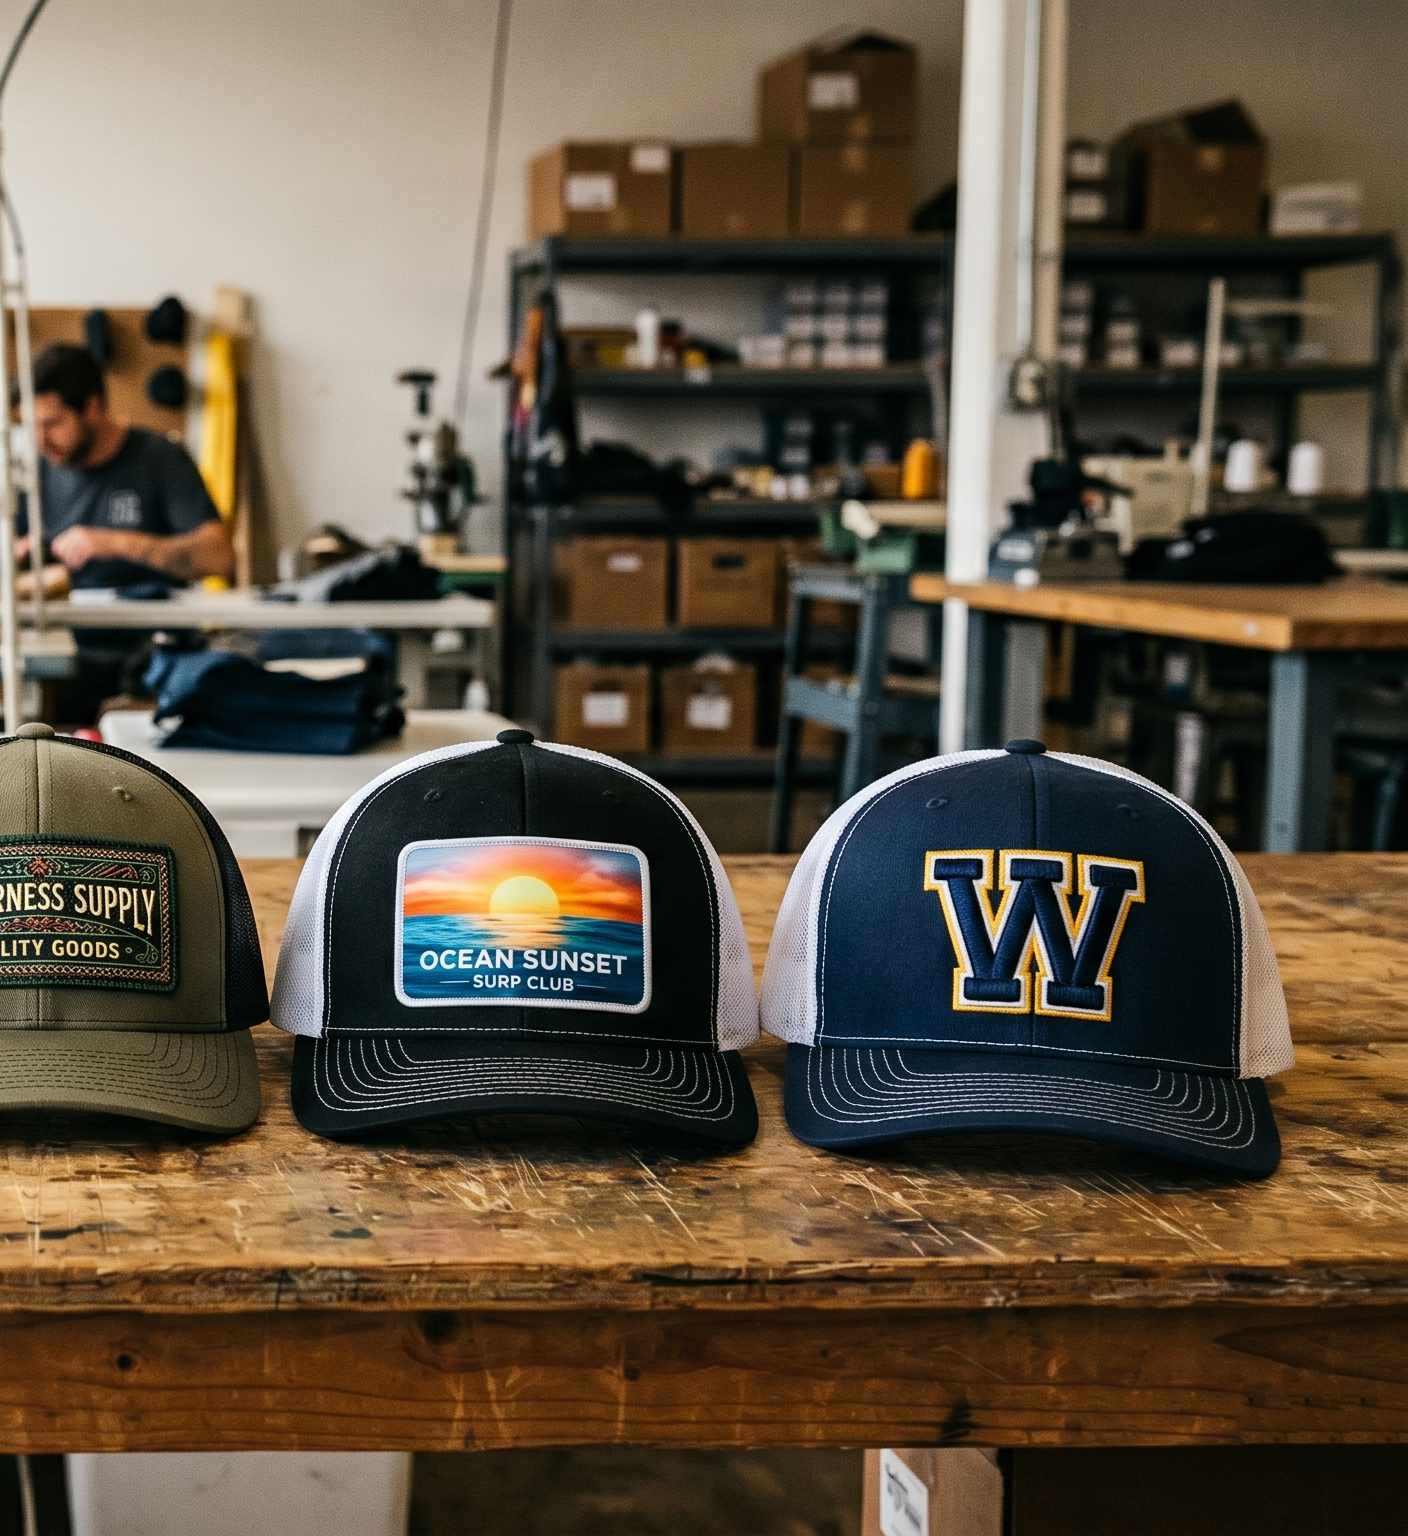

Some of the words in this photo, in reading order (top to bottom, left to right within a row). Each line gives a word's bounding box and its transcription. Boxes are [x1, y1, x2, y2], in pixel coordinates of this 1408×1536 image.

[74, 884, 155, 936] SUPPLY
[924, 849, 1145, 1022] W
[52, 940, 120, 959] GOODS
[419, 949, 514, 971] OCEAN
[523, 950, 628, 975] SUNSET
[527, 975, 574, 992] CLUB
